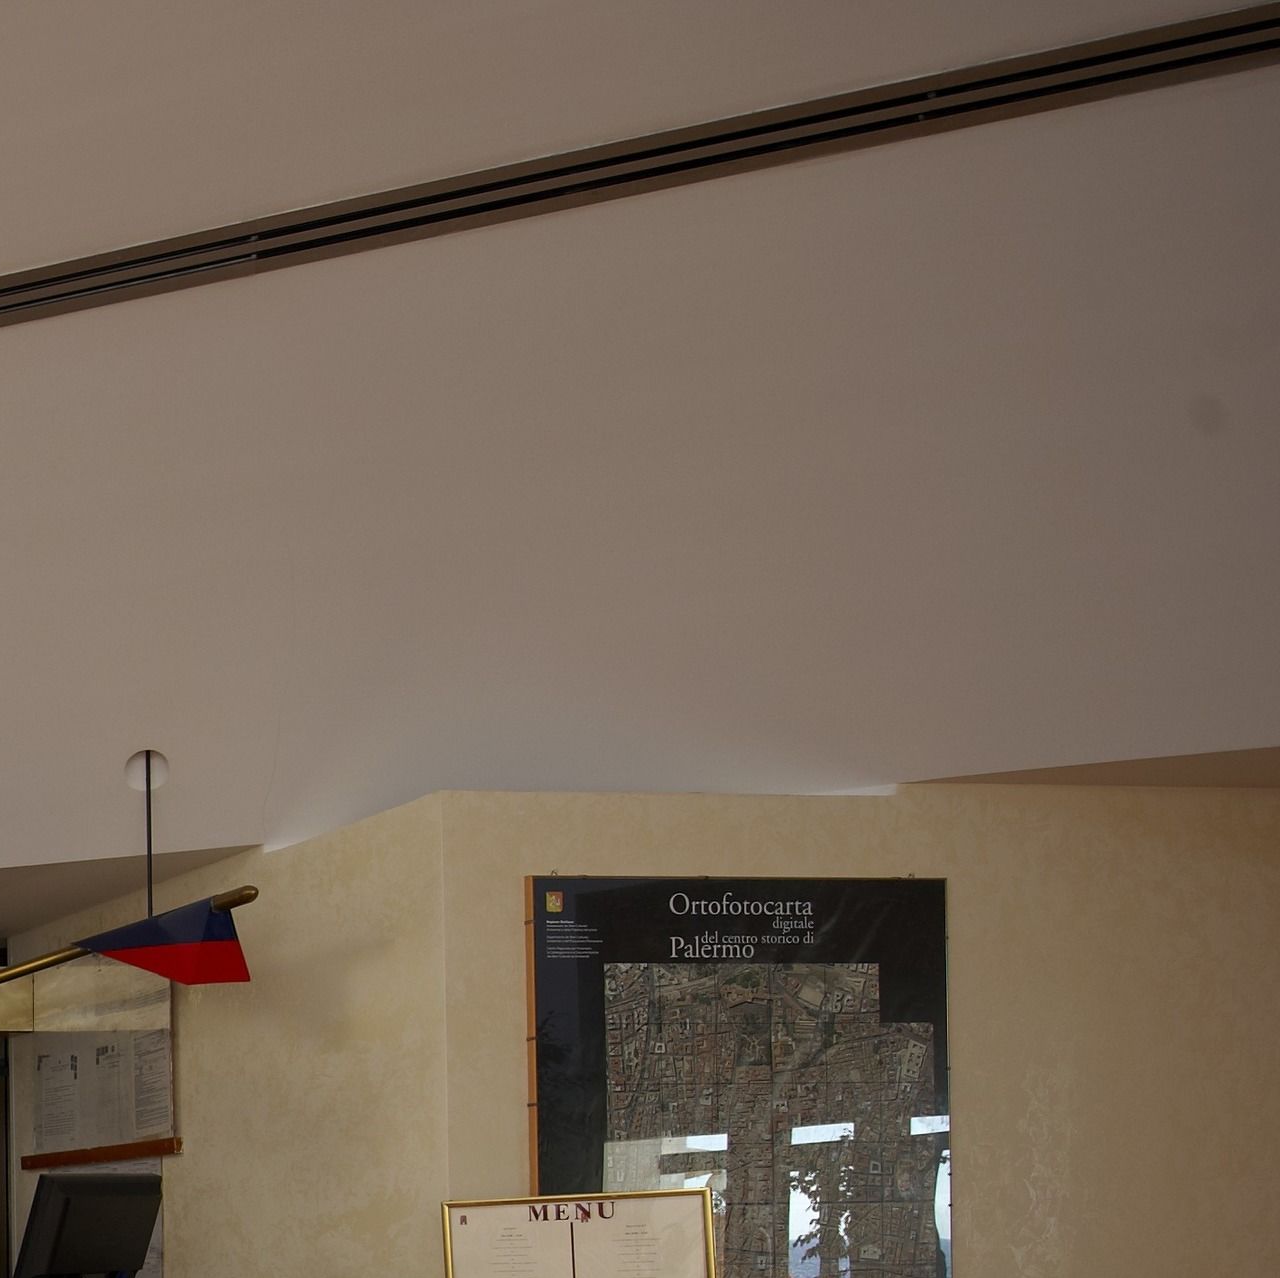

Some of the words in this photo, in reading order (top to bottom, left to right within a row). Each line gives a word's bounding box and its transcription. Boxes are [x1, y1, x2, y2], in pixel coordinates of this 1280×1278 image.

[669, 892, 813, 916] Ortofotocarta
[772, 916, 814, 933] digitale
[670, 936, 755, 958] Palermo
[701, 930, 718, 944] del
[722, 933, 758, 944] centro
[760, 932, 799, 944] storico
[802, 931, 814, 944] di
[528, 1201, 616, 1222] MENU
